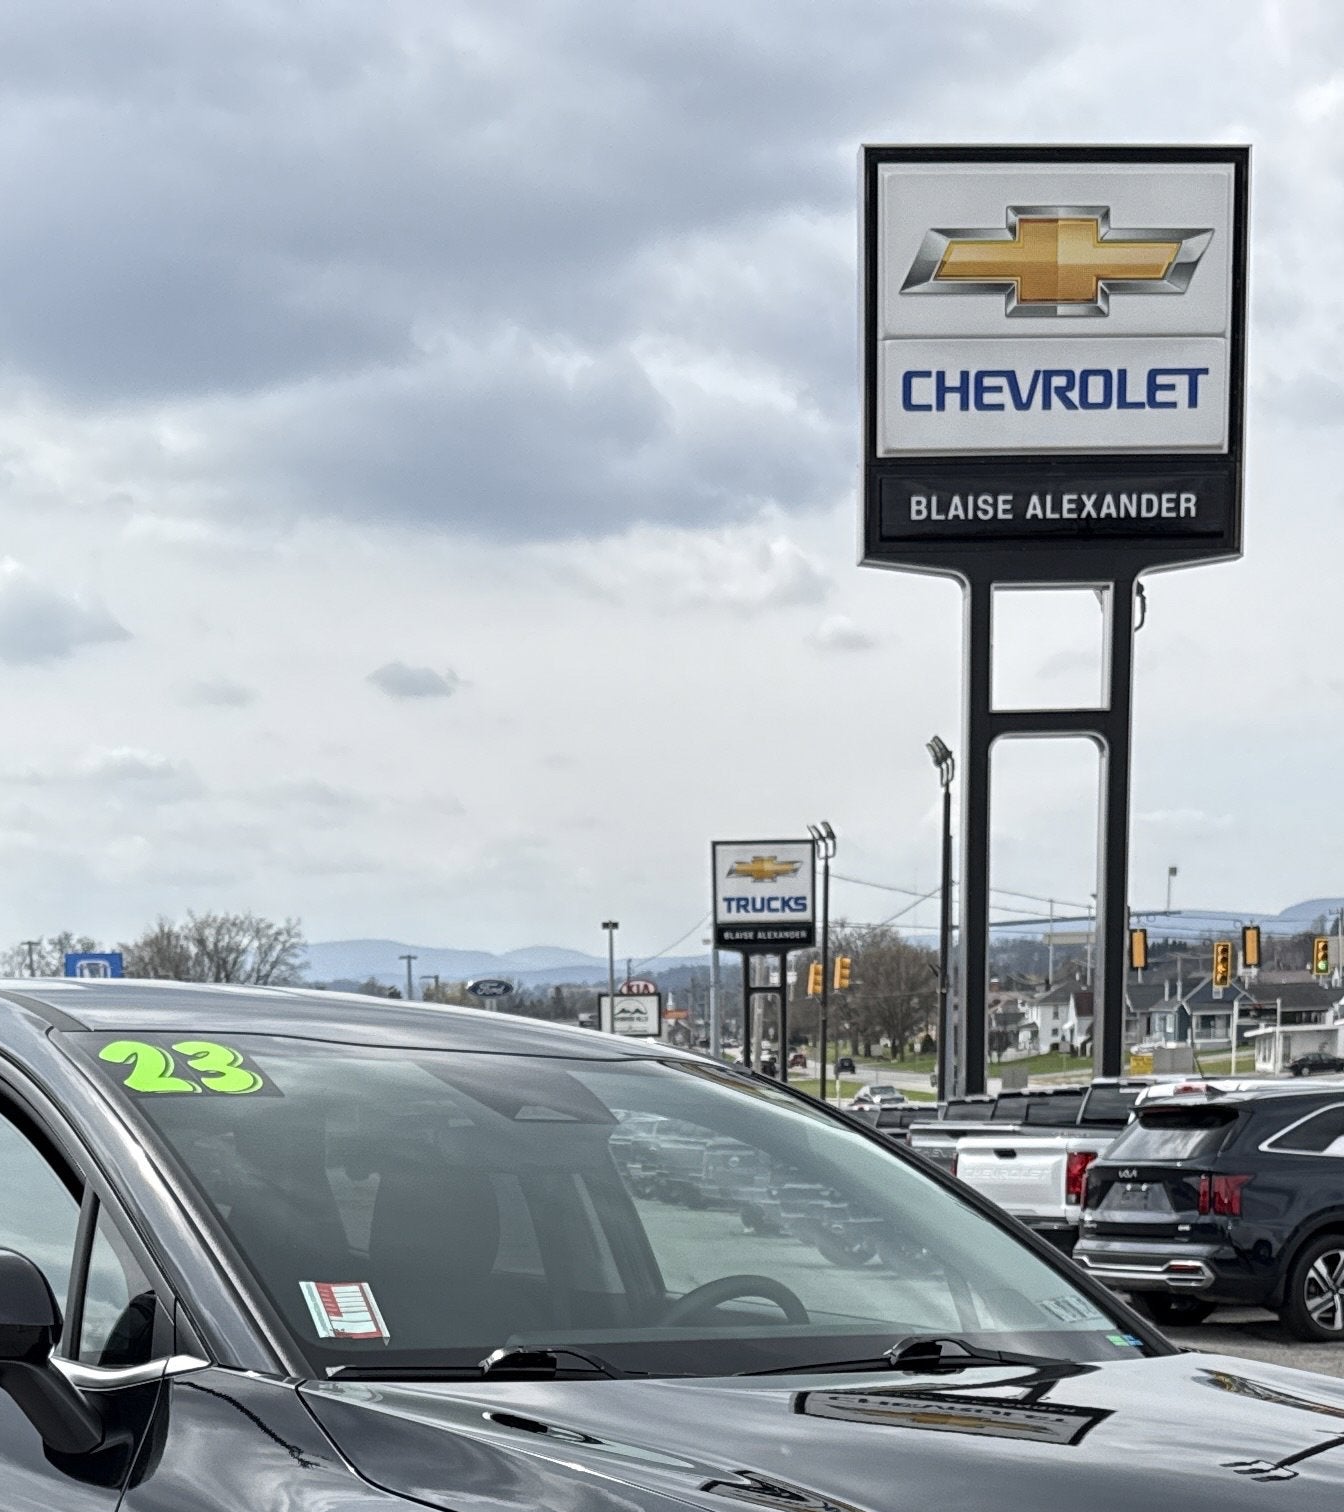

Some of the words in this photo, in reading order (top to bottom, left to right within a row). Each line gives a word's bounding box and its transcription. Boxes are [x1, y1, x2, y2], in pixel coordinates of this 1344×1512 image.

[902, 367, 1209, 412] CHEVROLET
[910, 494, 1013, 521] BLAISE
[1026, 493, 1197, 519] ALEXANDER
[722, 896, 807, 914] TRUCKS
[98, 1040, 264, 1095] 23
